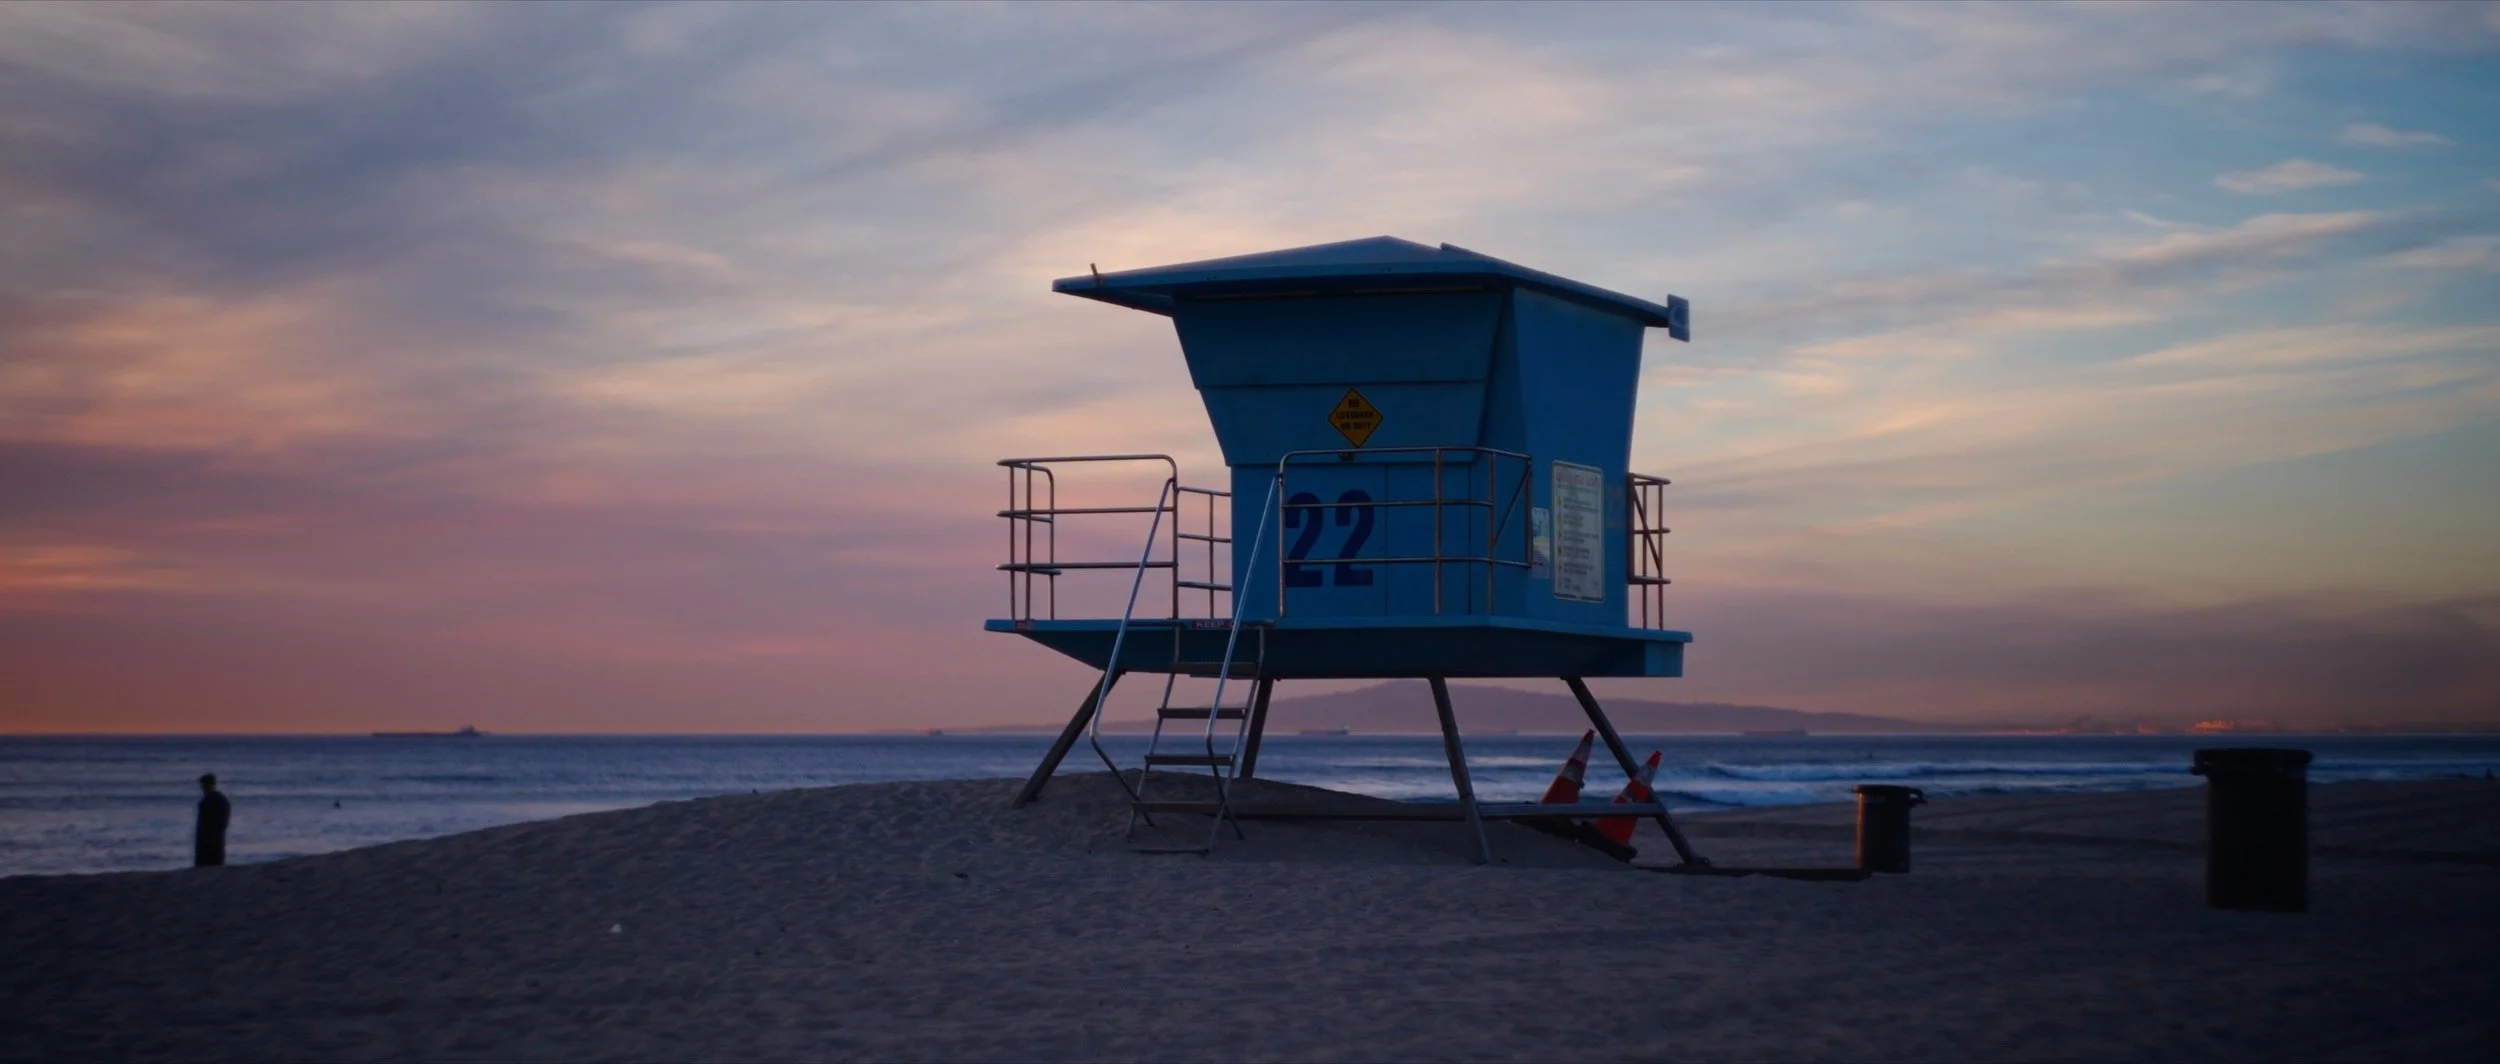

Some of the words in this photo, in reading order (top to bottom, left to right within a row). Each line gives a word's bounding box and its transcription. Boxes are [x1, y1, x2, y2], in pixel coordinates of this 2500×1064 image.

[1349, 398, 1360, 408] NO
[1354, 421, 1371, 430] DUTY
[1285, 489, 1374, 587] 22
[1195, 619, 1225, 629] KEEP
